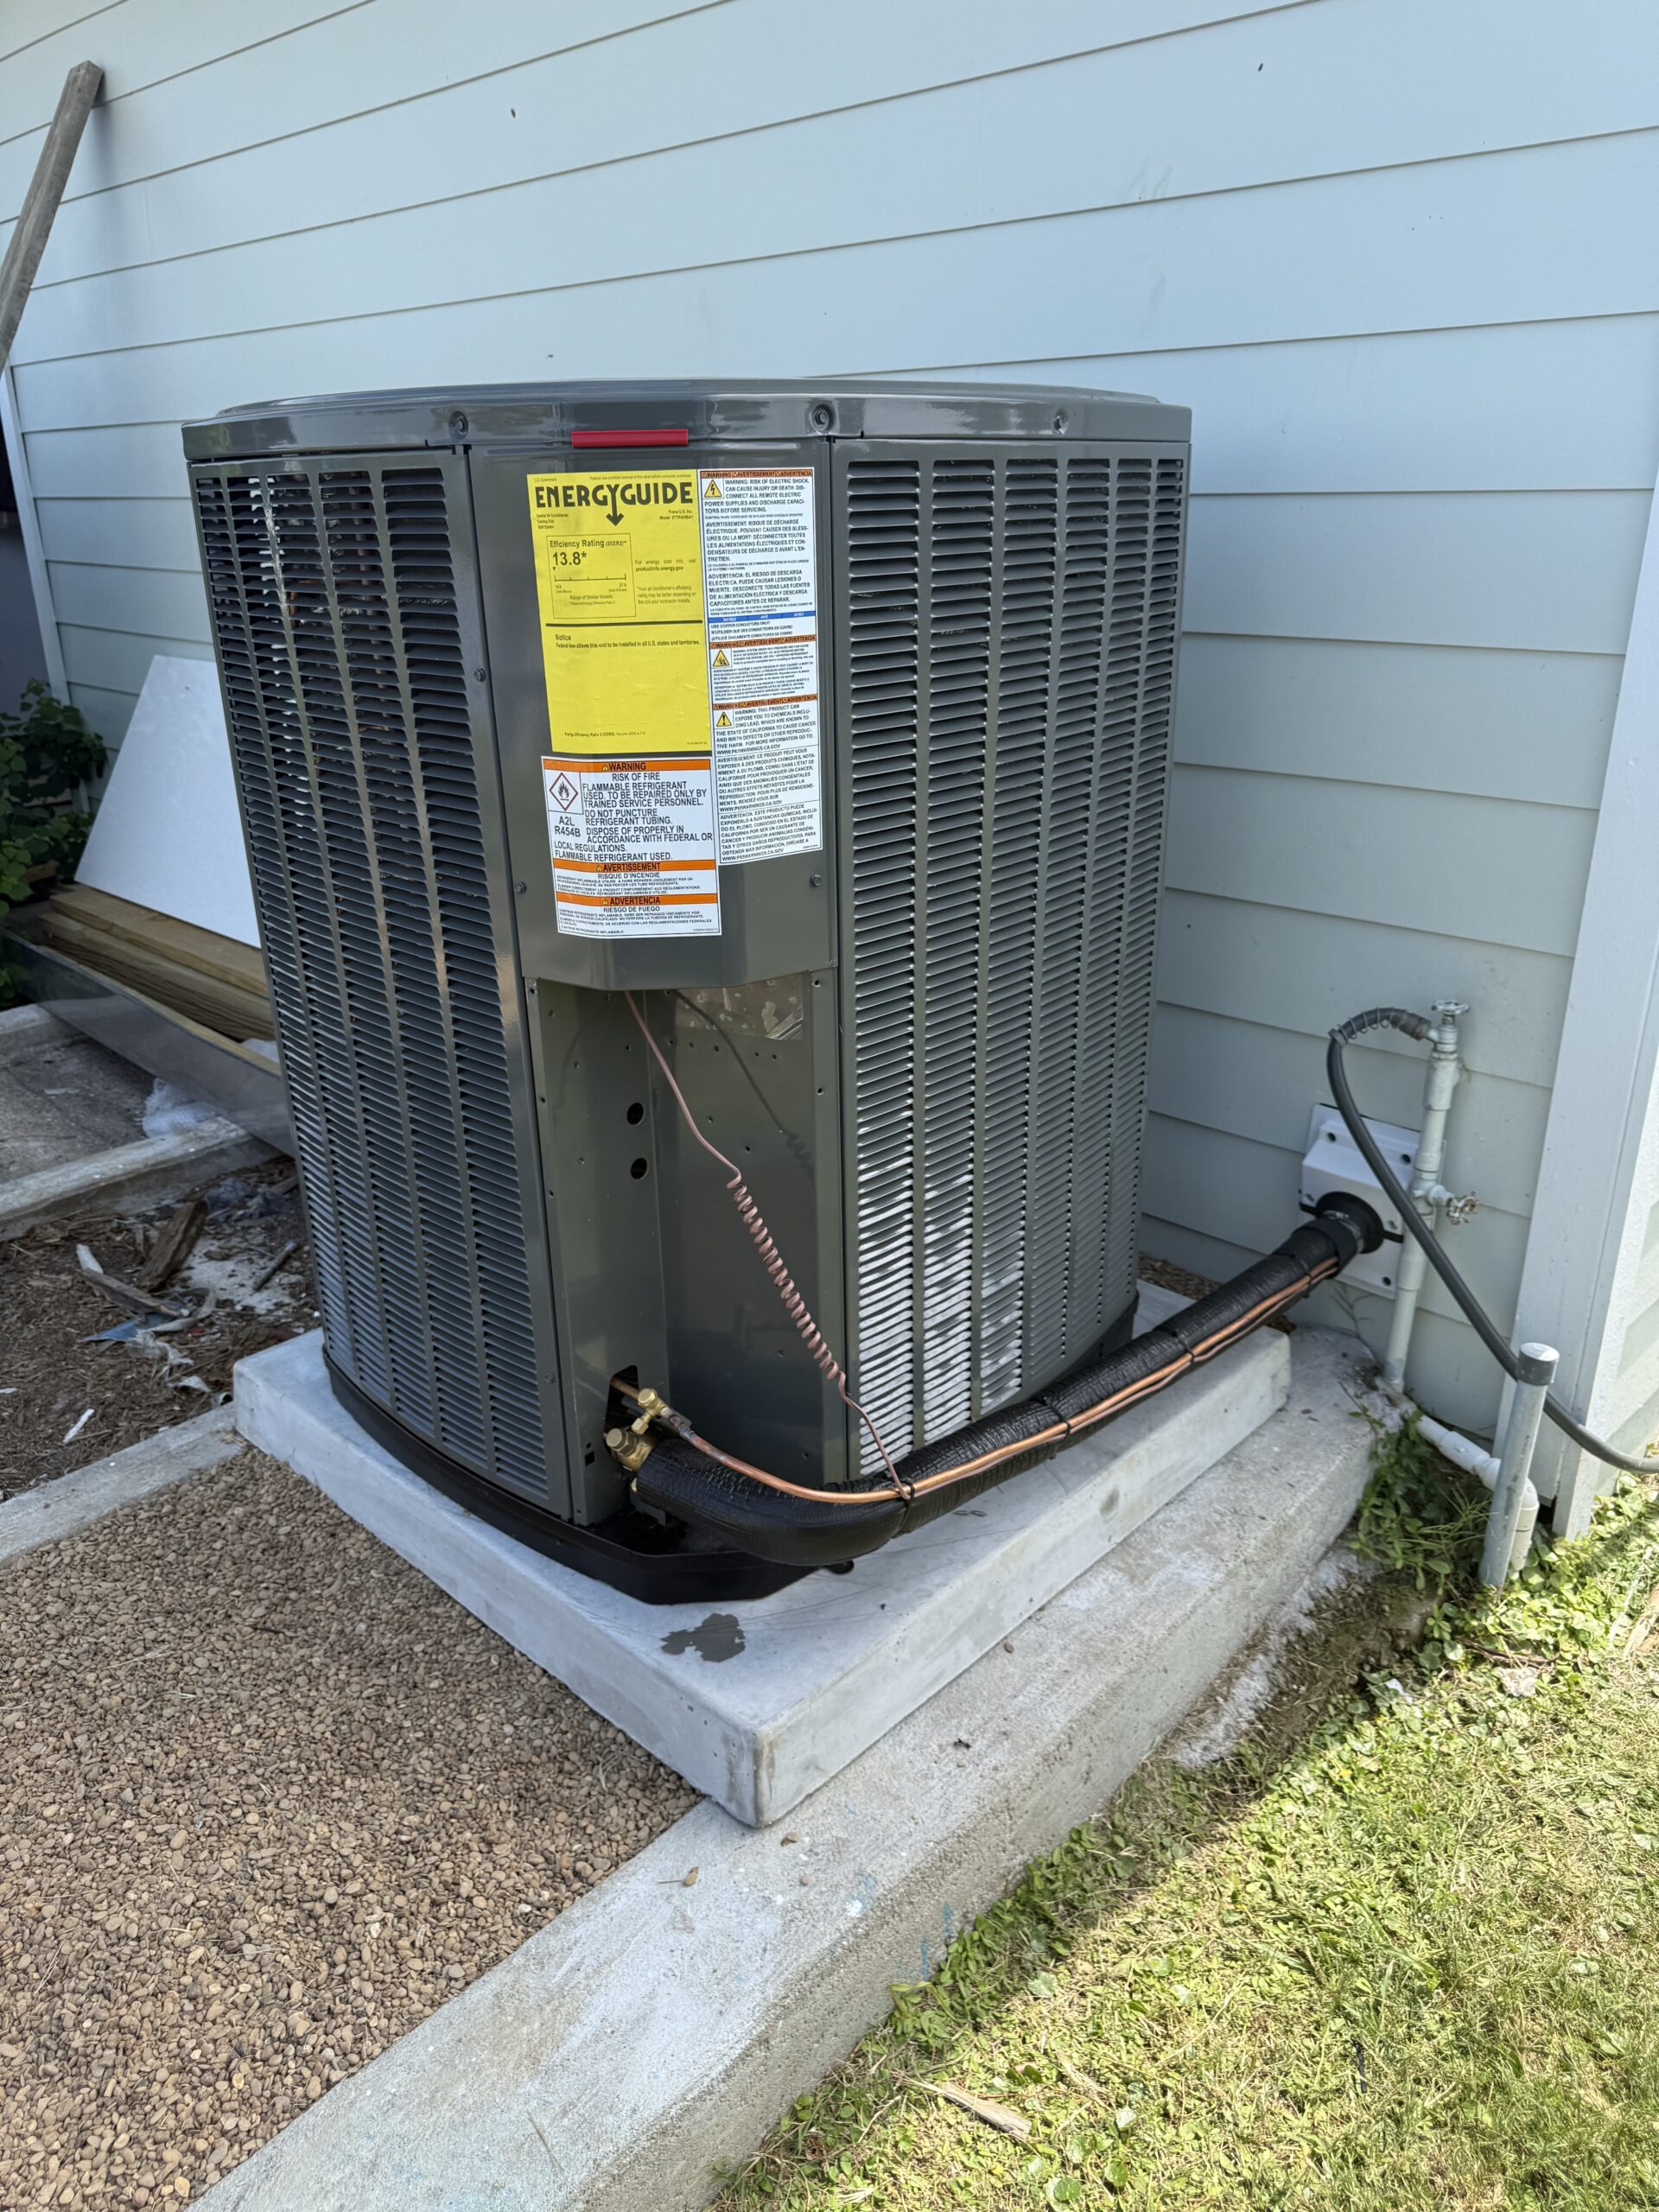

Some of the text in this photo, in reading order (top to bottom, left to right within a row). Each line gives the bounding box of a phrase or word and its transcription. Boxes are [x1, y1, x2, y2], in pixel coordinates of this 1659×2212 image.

[535, 482, 693, 510] ENERGYGUIDE
[550, 540, 580, 549] Efficiency
[582, 539, 604, 548] Rating
[609, 762, 646, 771] WARNING
[583, 781, 687, 791] FLAMMABLE REFRIGERANT
[583, 791, 606, 800] USED.
[633, 790, 671, 798] REPAIRED
[615, 809, 658, 817] PUNCTURE
[559, 817, 575, 826] A2L
[555, 826, 581, 836] R454B
[587, 827, 620, 836] DISPOSE
[588, 835, 640, 843] ACCORDANCE
[664, 833, 699, 842] FEDERAL
[555, 841, 626, 852] LOCAL REGULATIONS.
[556, 850, 672, 861] FLAMMABLE REFRIGERANT USED.
[603, 863, 660, 872] AVERTISSEMENT
[610, 896, 660, 906] ADVERTENCIA
